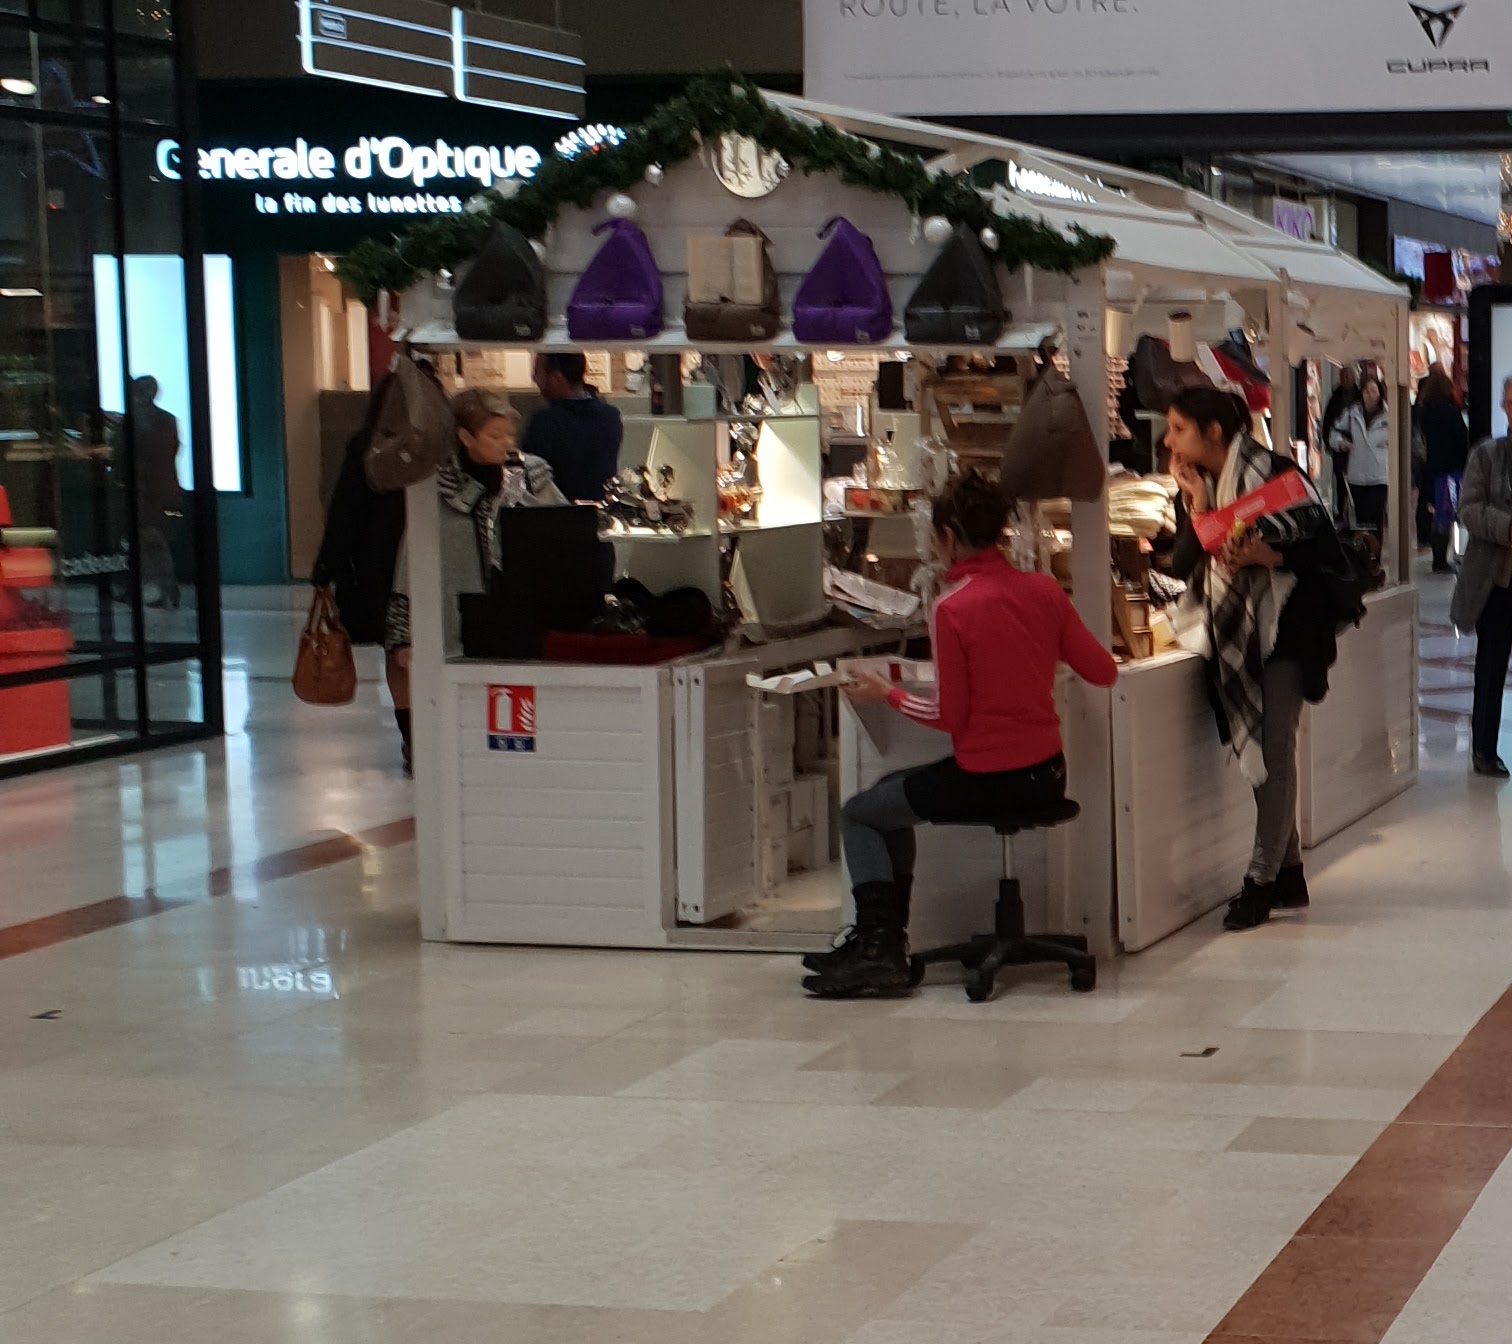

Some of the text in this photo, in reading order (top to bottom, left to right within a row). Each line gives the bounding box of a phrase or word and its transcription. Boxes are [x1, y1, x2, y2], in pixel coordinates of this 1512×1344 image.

[1386, 57, 1490, 74] CUPRA
[344, 135, 542, 188] d'Optique
[254, 191, 463, 214] la fin des lunettes
